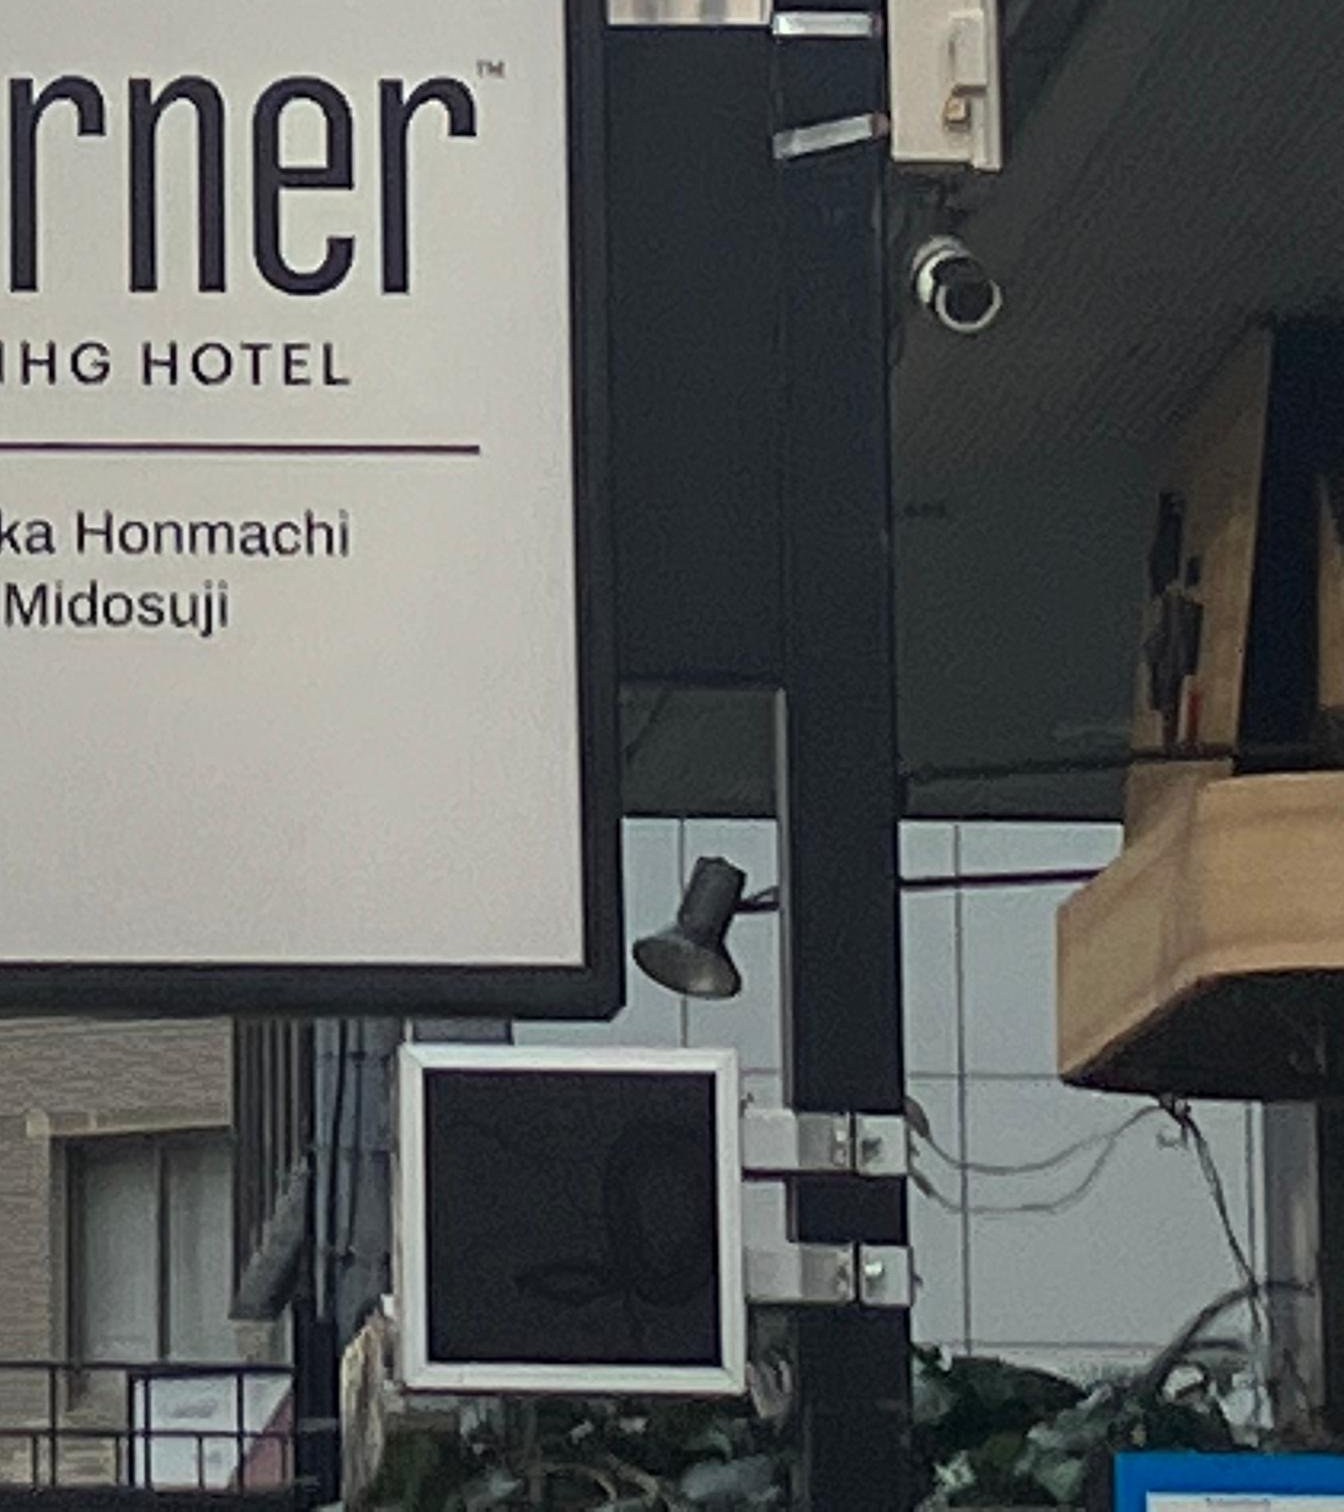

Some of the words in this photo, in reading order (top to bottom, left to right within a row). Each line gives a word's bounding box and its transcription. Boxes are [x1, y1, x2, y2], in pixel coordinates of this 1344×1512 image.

[142, 340, 350, 386] HOTEL
[76, 509, 350, 558] Honmachi
[4, 580, 229, 638] Midosuji
